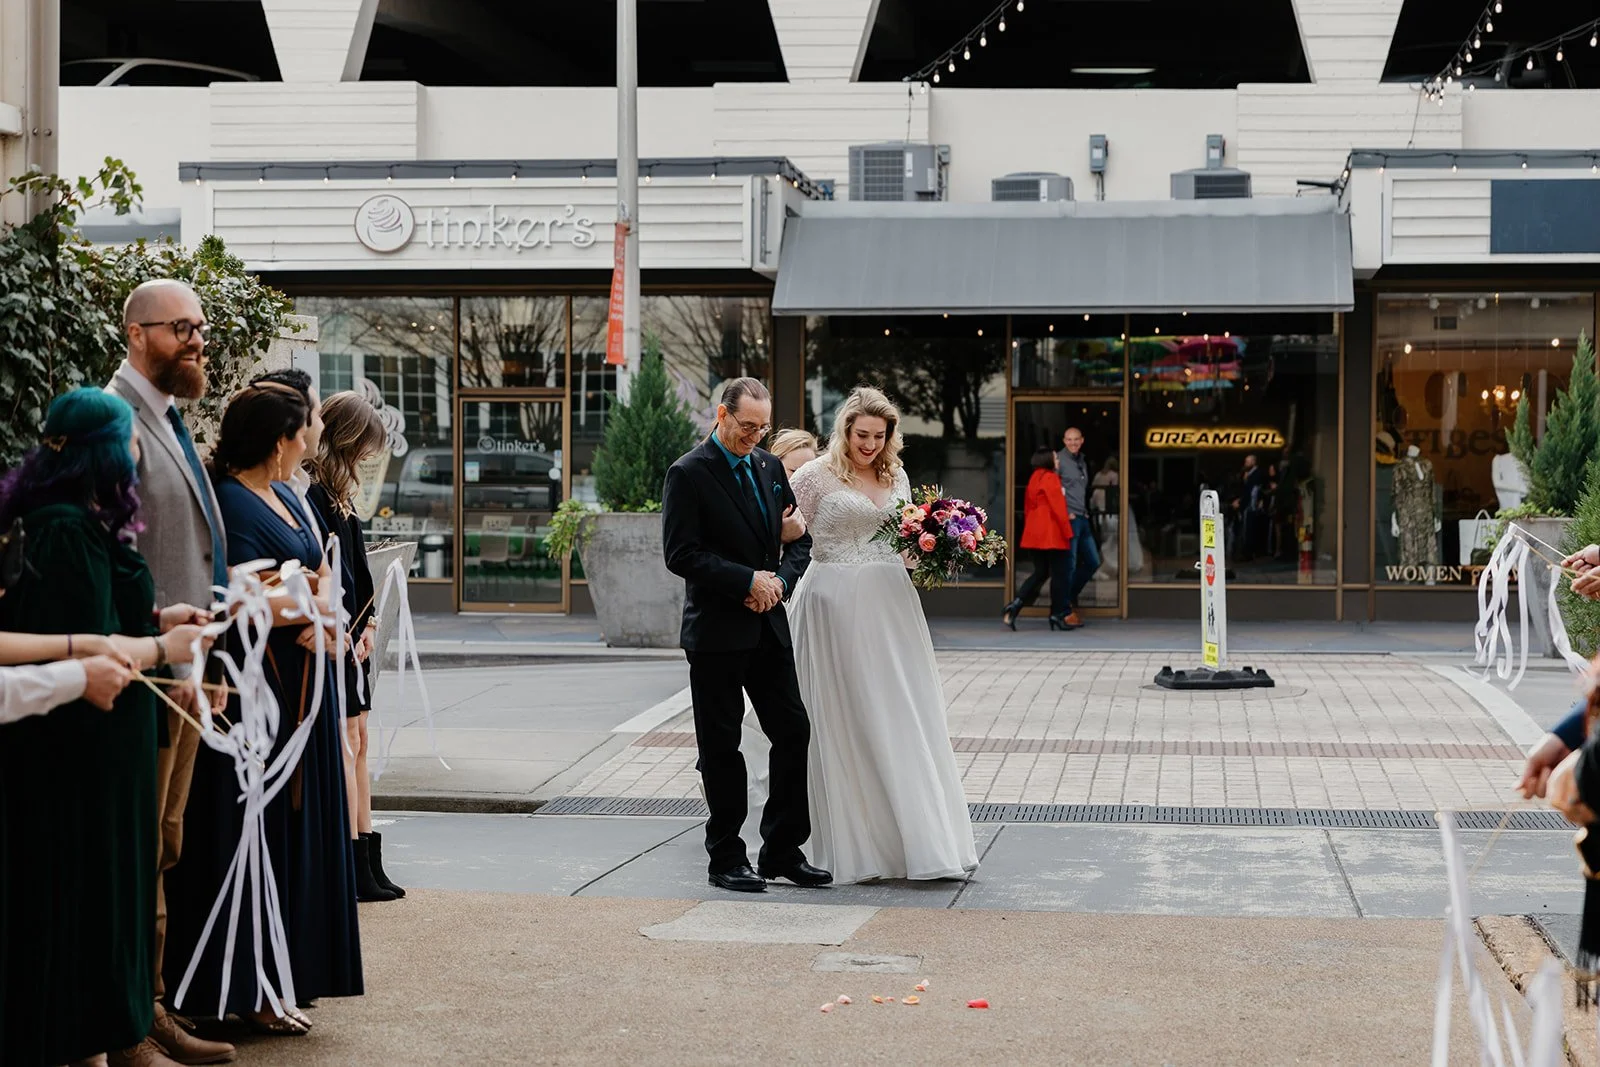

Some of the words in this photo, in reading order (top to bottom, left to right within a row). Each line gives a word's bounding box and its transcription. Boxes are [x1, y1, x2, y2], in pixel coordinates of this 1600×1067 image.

[424, 204, 598, 254] tinker's
[1148, 430, 1284, 445] DREAMGIRL
[496, 439, 547, 453] tinker's
[1385, 565, 1463, 581] WOMEN
